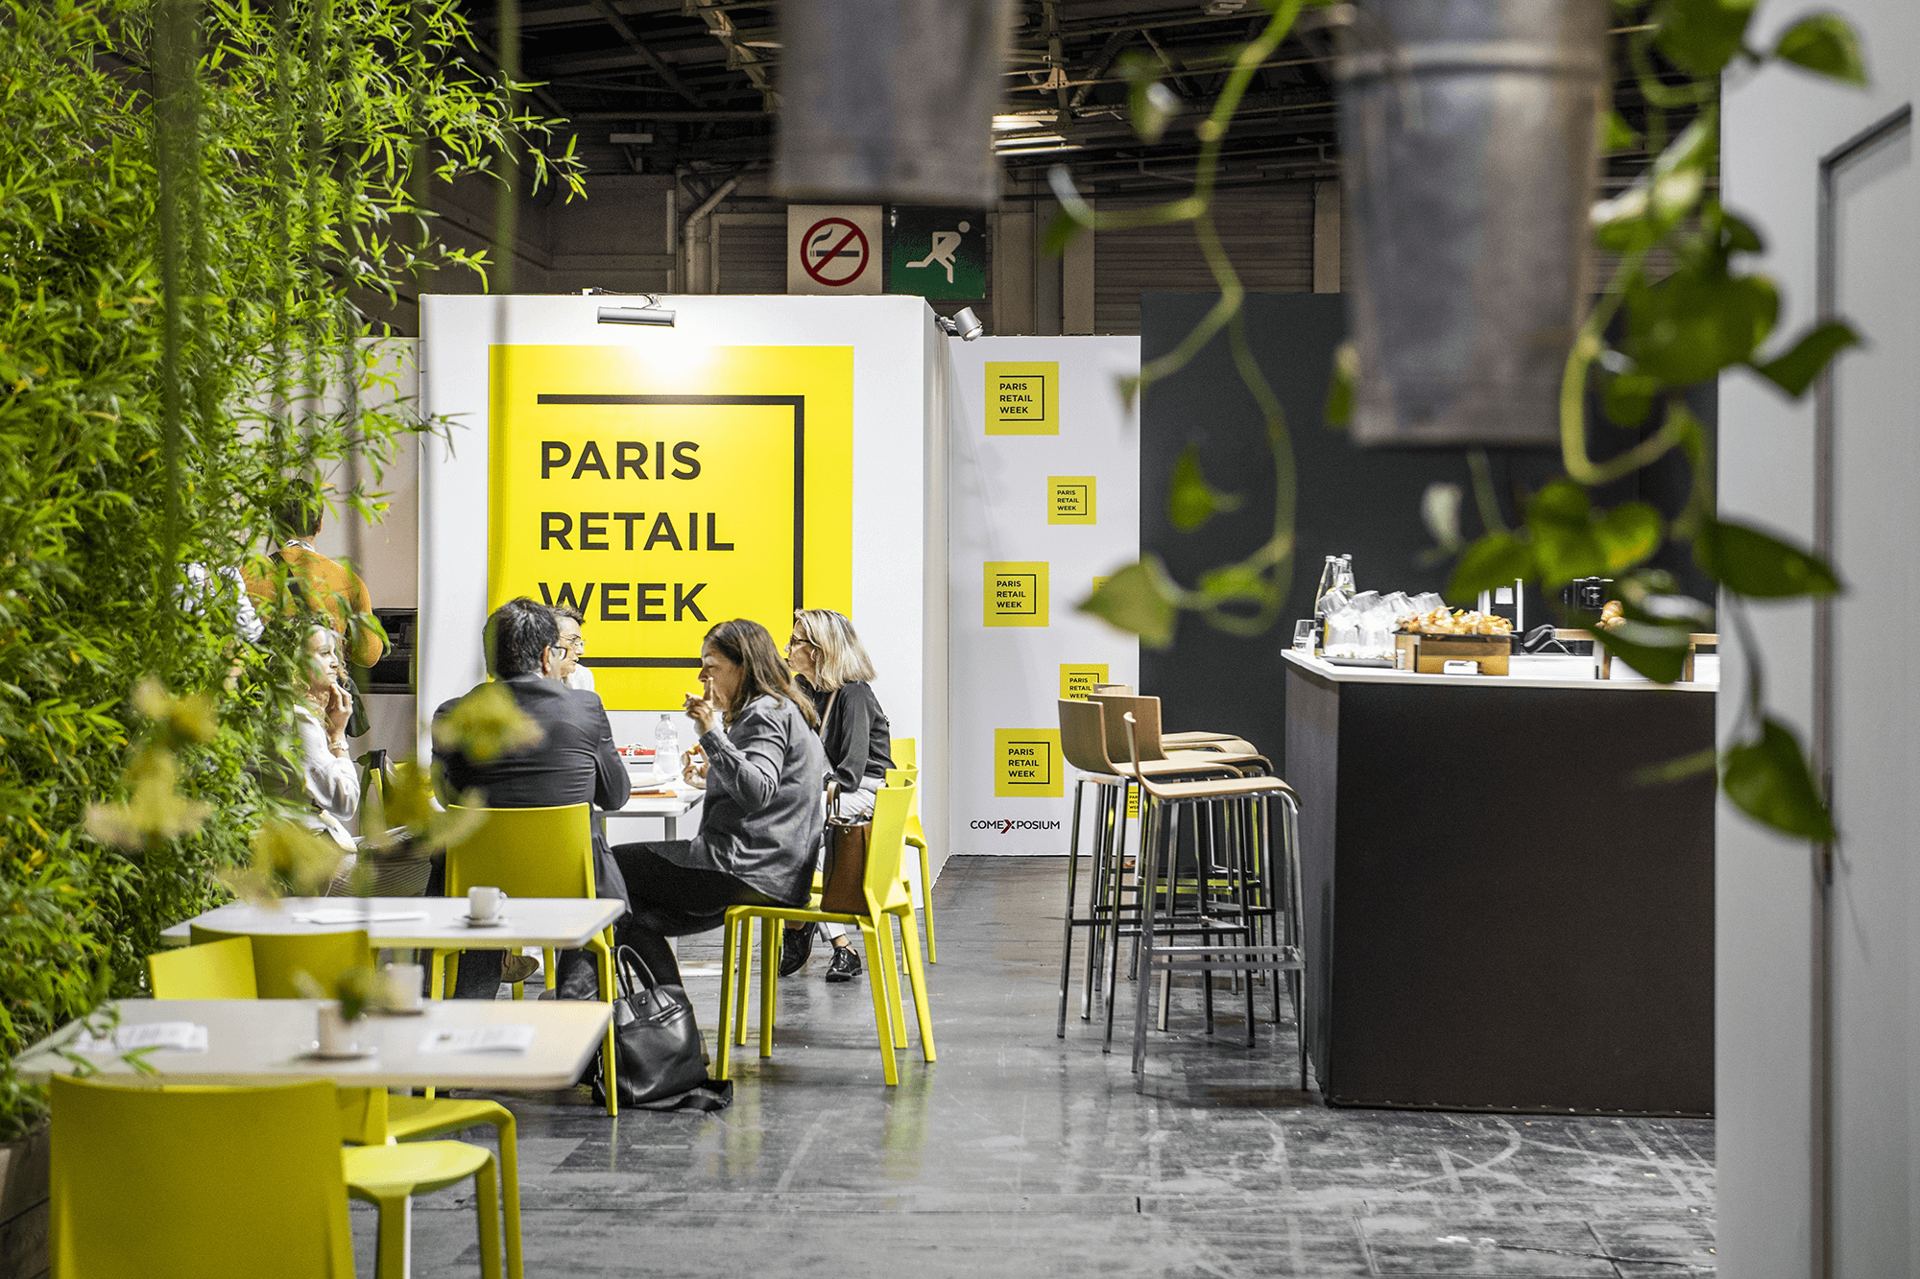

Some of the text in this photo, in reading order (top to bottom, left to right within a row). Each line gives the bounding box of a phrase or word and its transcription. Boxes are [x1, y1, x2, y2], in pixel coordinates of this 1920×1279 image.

[999, 382, 1028, 391] PARIS
[999, 394, 1033, 402] RETAIL
[999, 406, 1029, 414] WEEK
[541, 440, 702, 481] PARIS
[540, 511, 735, 552] RETAIL
[996, 580, 1022, 588] PARIS
[996, 590, 1026, 598] RETAIL
[538, 582, 708, 622] WEEK
[1008, 748, 1035, 756] PARIS
[1008, 759, 1040, 767] RETAIL
[1008, 770, 1036, 778] WEEK
[970, 819, 1061, 834] COMEXPOSIUM
